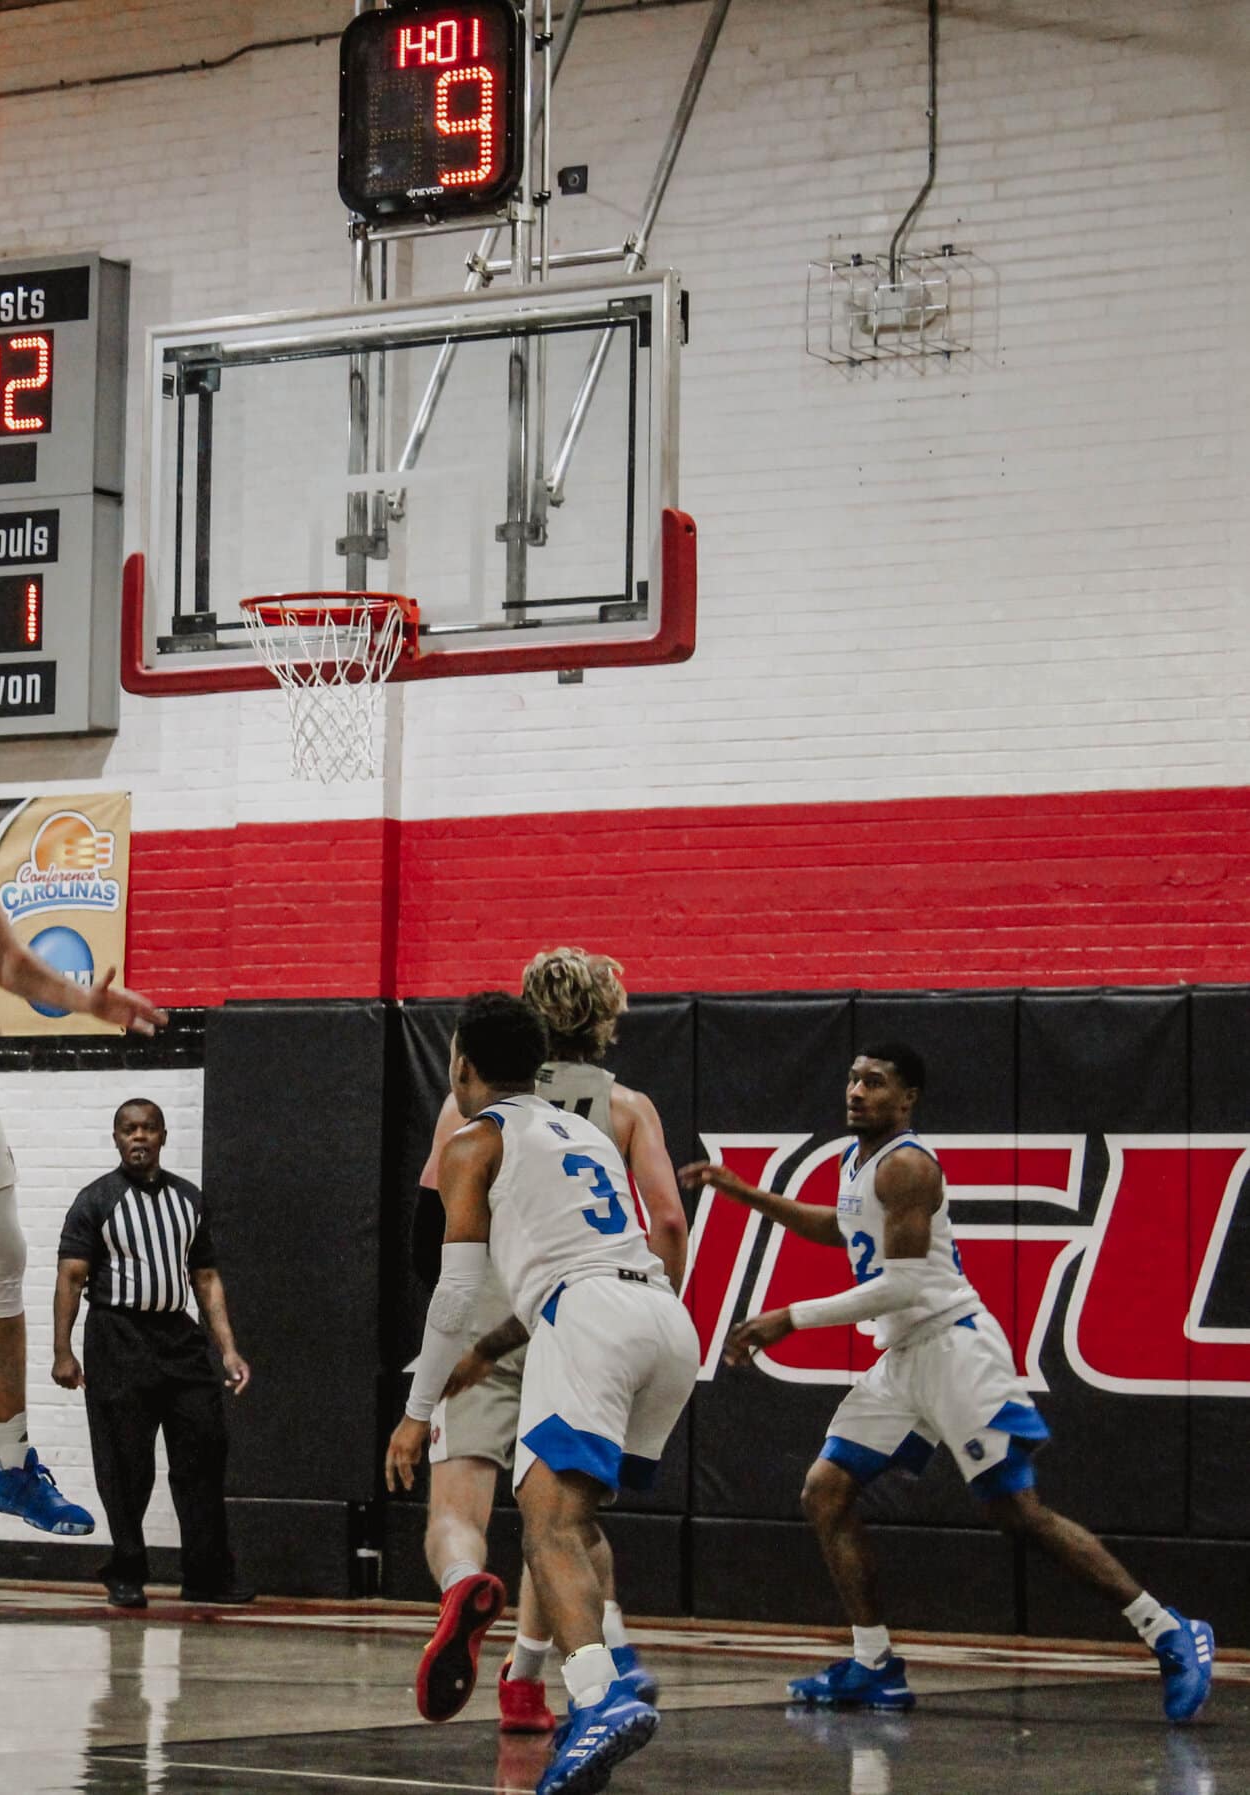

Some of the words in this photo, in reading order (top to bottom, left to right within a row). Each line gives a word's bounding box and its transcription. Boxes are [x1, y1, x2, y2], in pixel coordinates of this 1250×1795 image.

[399, 18, 479, 68] 14:01
[436, 66, 493, 186] 9
[27, 582, 38, 644] 1
[2, 882, 117, 910] CAROLINAS
[561, 1153, 628, 1235] 3
